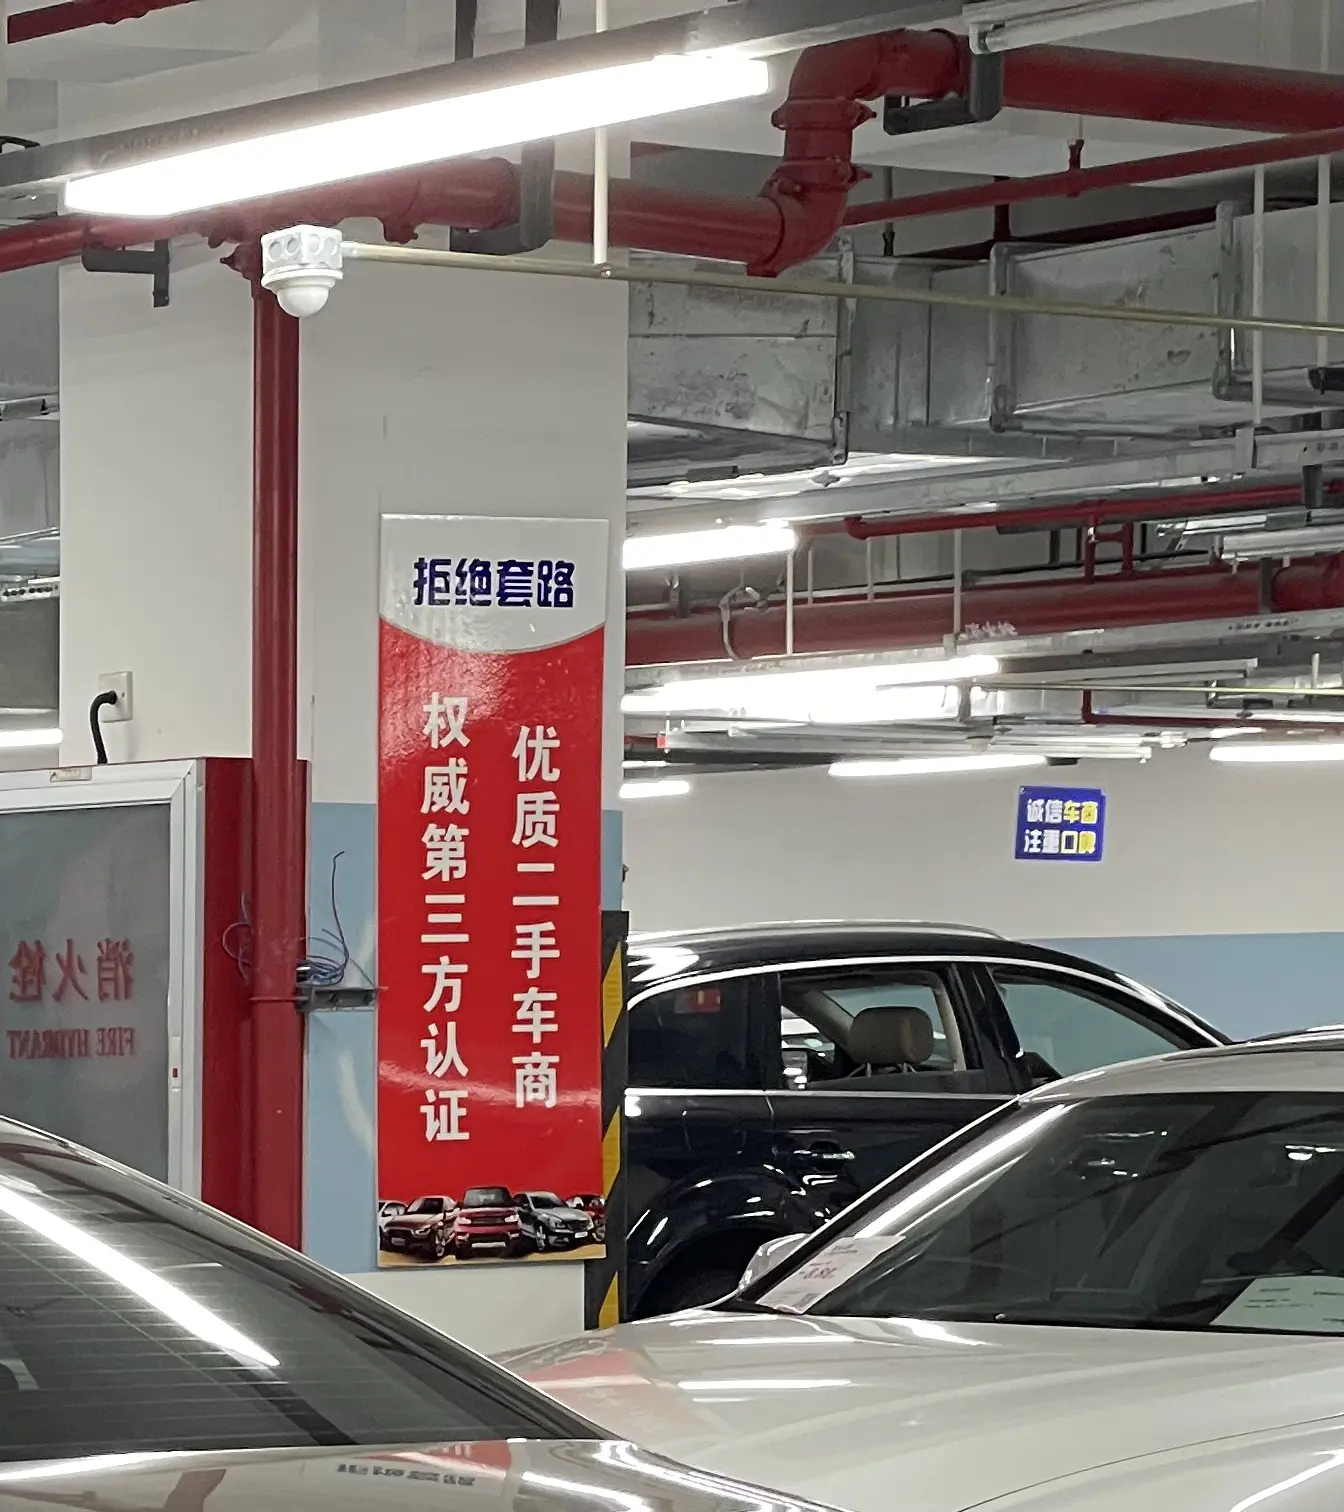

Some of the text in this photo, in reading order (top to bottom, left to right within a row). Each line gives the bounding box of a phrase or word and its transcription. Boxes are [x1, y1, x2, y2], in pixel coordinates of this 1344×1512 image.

[413, 556, 575, 608] 拒绝套路
[419, 692, 470, 1144] 权威第三方认证
[511, 725, 561, 1110] 优质二手车商
